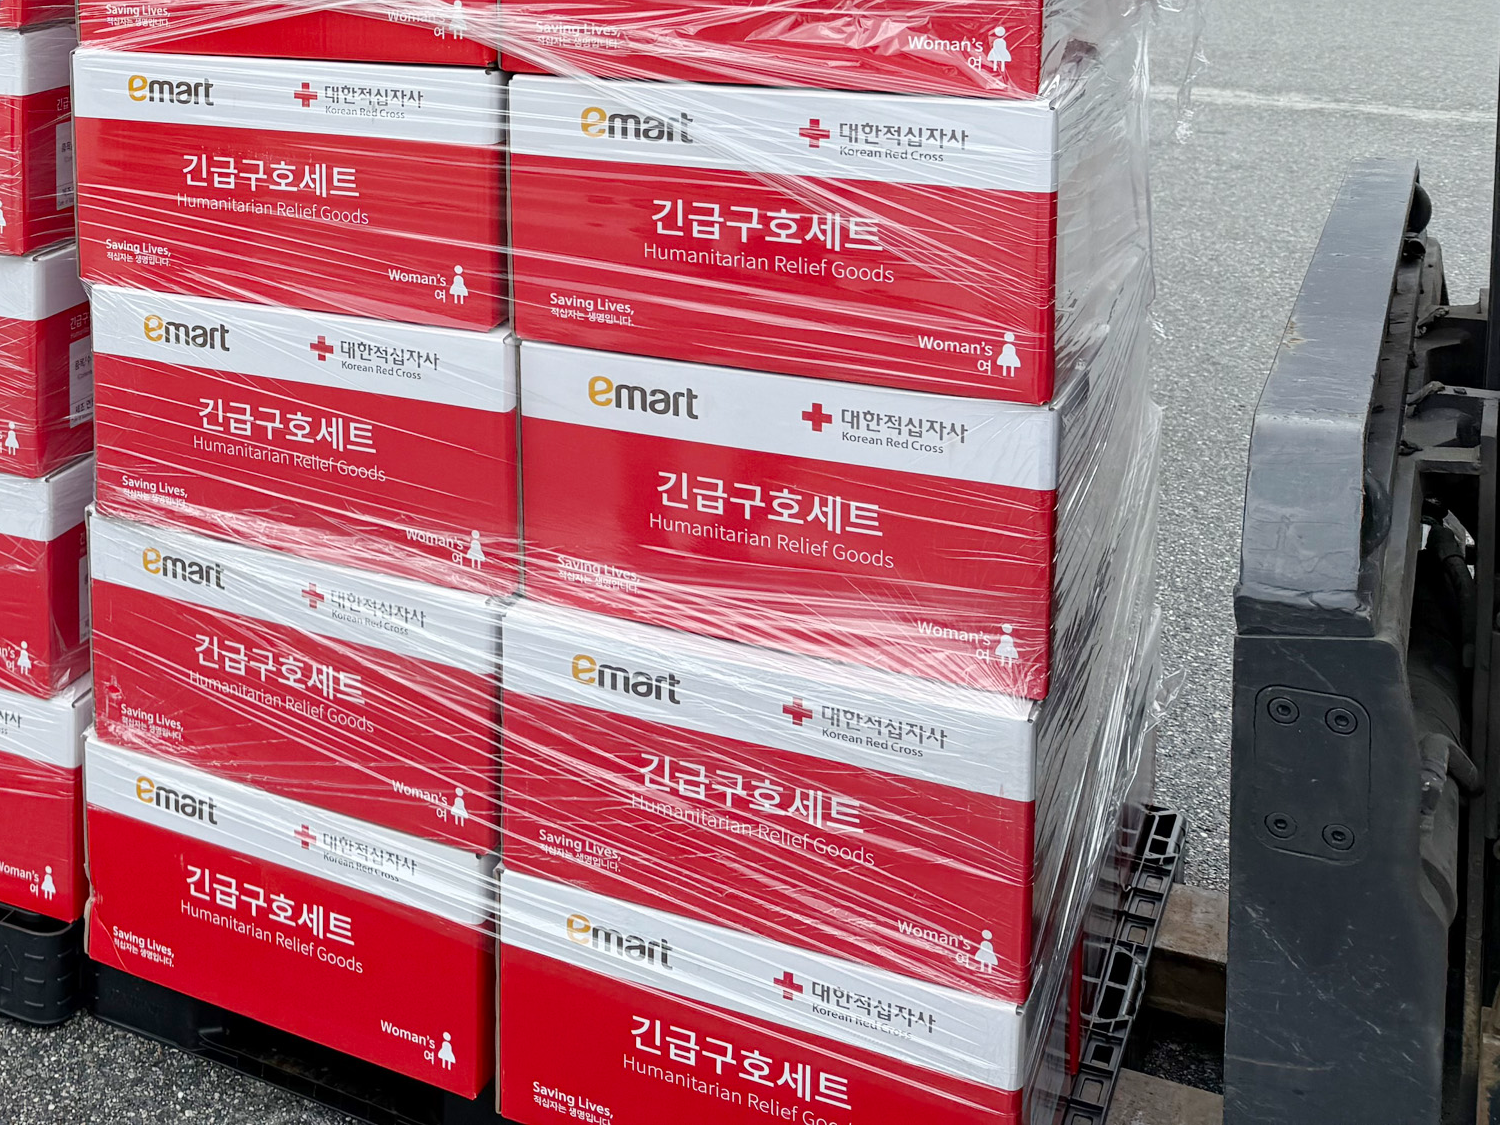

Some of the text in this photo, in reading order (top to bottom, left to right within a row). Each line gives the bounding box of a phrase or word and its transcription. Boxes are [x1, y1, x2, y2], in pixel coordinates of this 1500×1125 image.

[128, 74, 214, 107] emart
[324, 85, 424, 109] 대한적십자사
[581, 106, 694, 145] emart
[839, 122, 970, 151] 대한적십자사
[182, 153, 360, 198] 긴급구호세트
[177, 192, 370, 225] Humanitarian Relief Goods
[652, 198, 884, 252] 긴급구호세트
[388, 268, 447, 287] Woman's
[643, 242, 895, 284] Humanitarian Relief Goods
[434, 289, 447, 304] 여
[549, 292, 635, 316] Saving Lives,
[143, 314, 230, 353] emart
[918, 335, 994, 357] Woman's
[340, 340, 440, 371] 대한적십자사
[341, 360, 422, 381] Korean Red Cross
[977, 359, 994, 376] 여
[588, 376, 699, 420] emart
[198, 398, 377, 454] 긴급구호세트
[841, 409, 969, 445] 대한적십자사
[842, 431, 945, 455] Korean Red Cross
[657, 471, 884, 537] 긴급구호세트
[649, 513, 895, 569] Humanitarian Relief Goods
[141, 546, 226, 592] emart
[195, 634, 365, 705] 긴급구호세트
[571, 654, 681, 705] emart
[135, 776, 218, 826] emart
[639, 753, 864, 835] 긴급구호세트
[29, 883, 40, 896] 여
[186, 865, 355, 946] 긴급구호세트
[112, 926, 175, 959] Saving Lives,
[180, 899, 363, 975] Humanitarian Relief Goods
[566, 914, 674, 971] emart
[380, 1020, 436, 1050] Woman's
[423, 1050, 436, 1065] 여
[631, 1015, 853, 1111] 긴급구호세트
[532, 1081, 614, 1119] Saving Lives,
